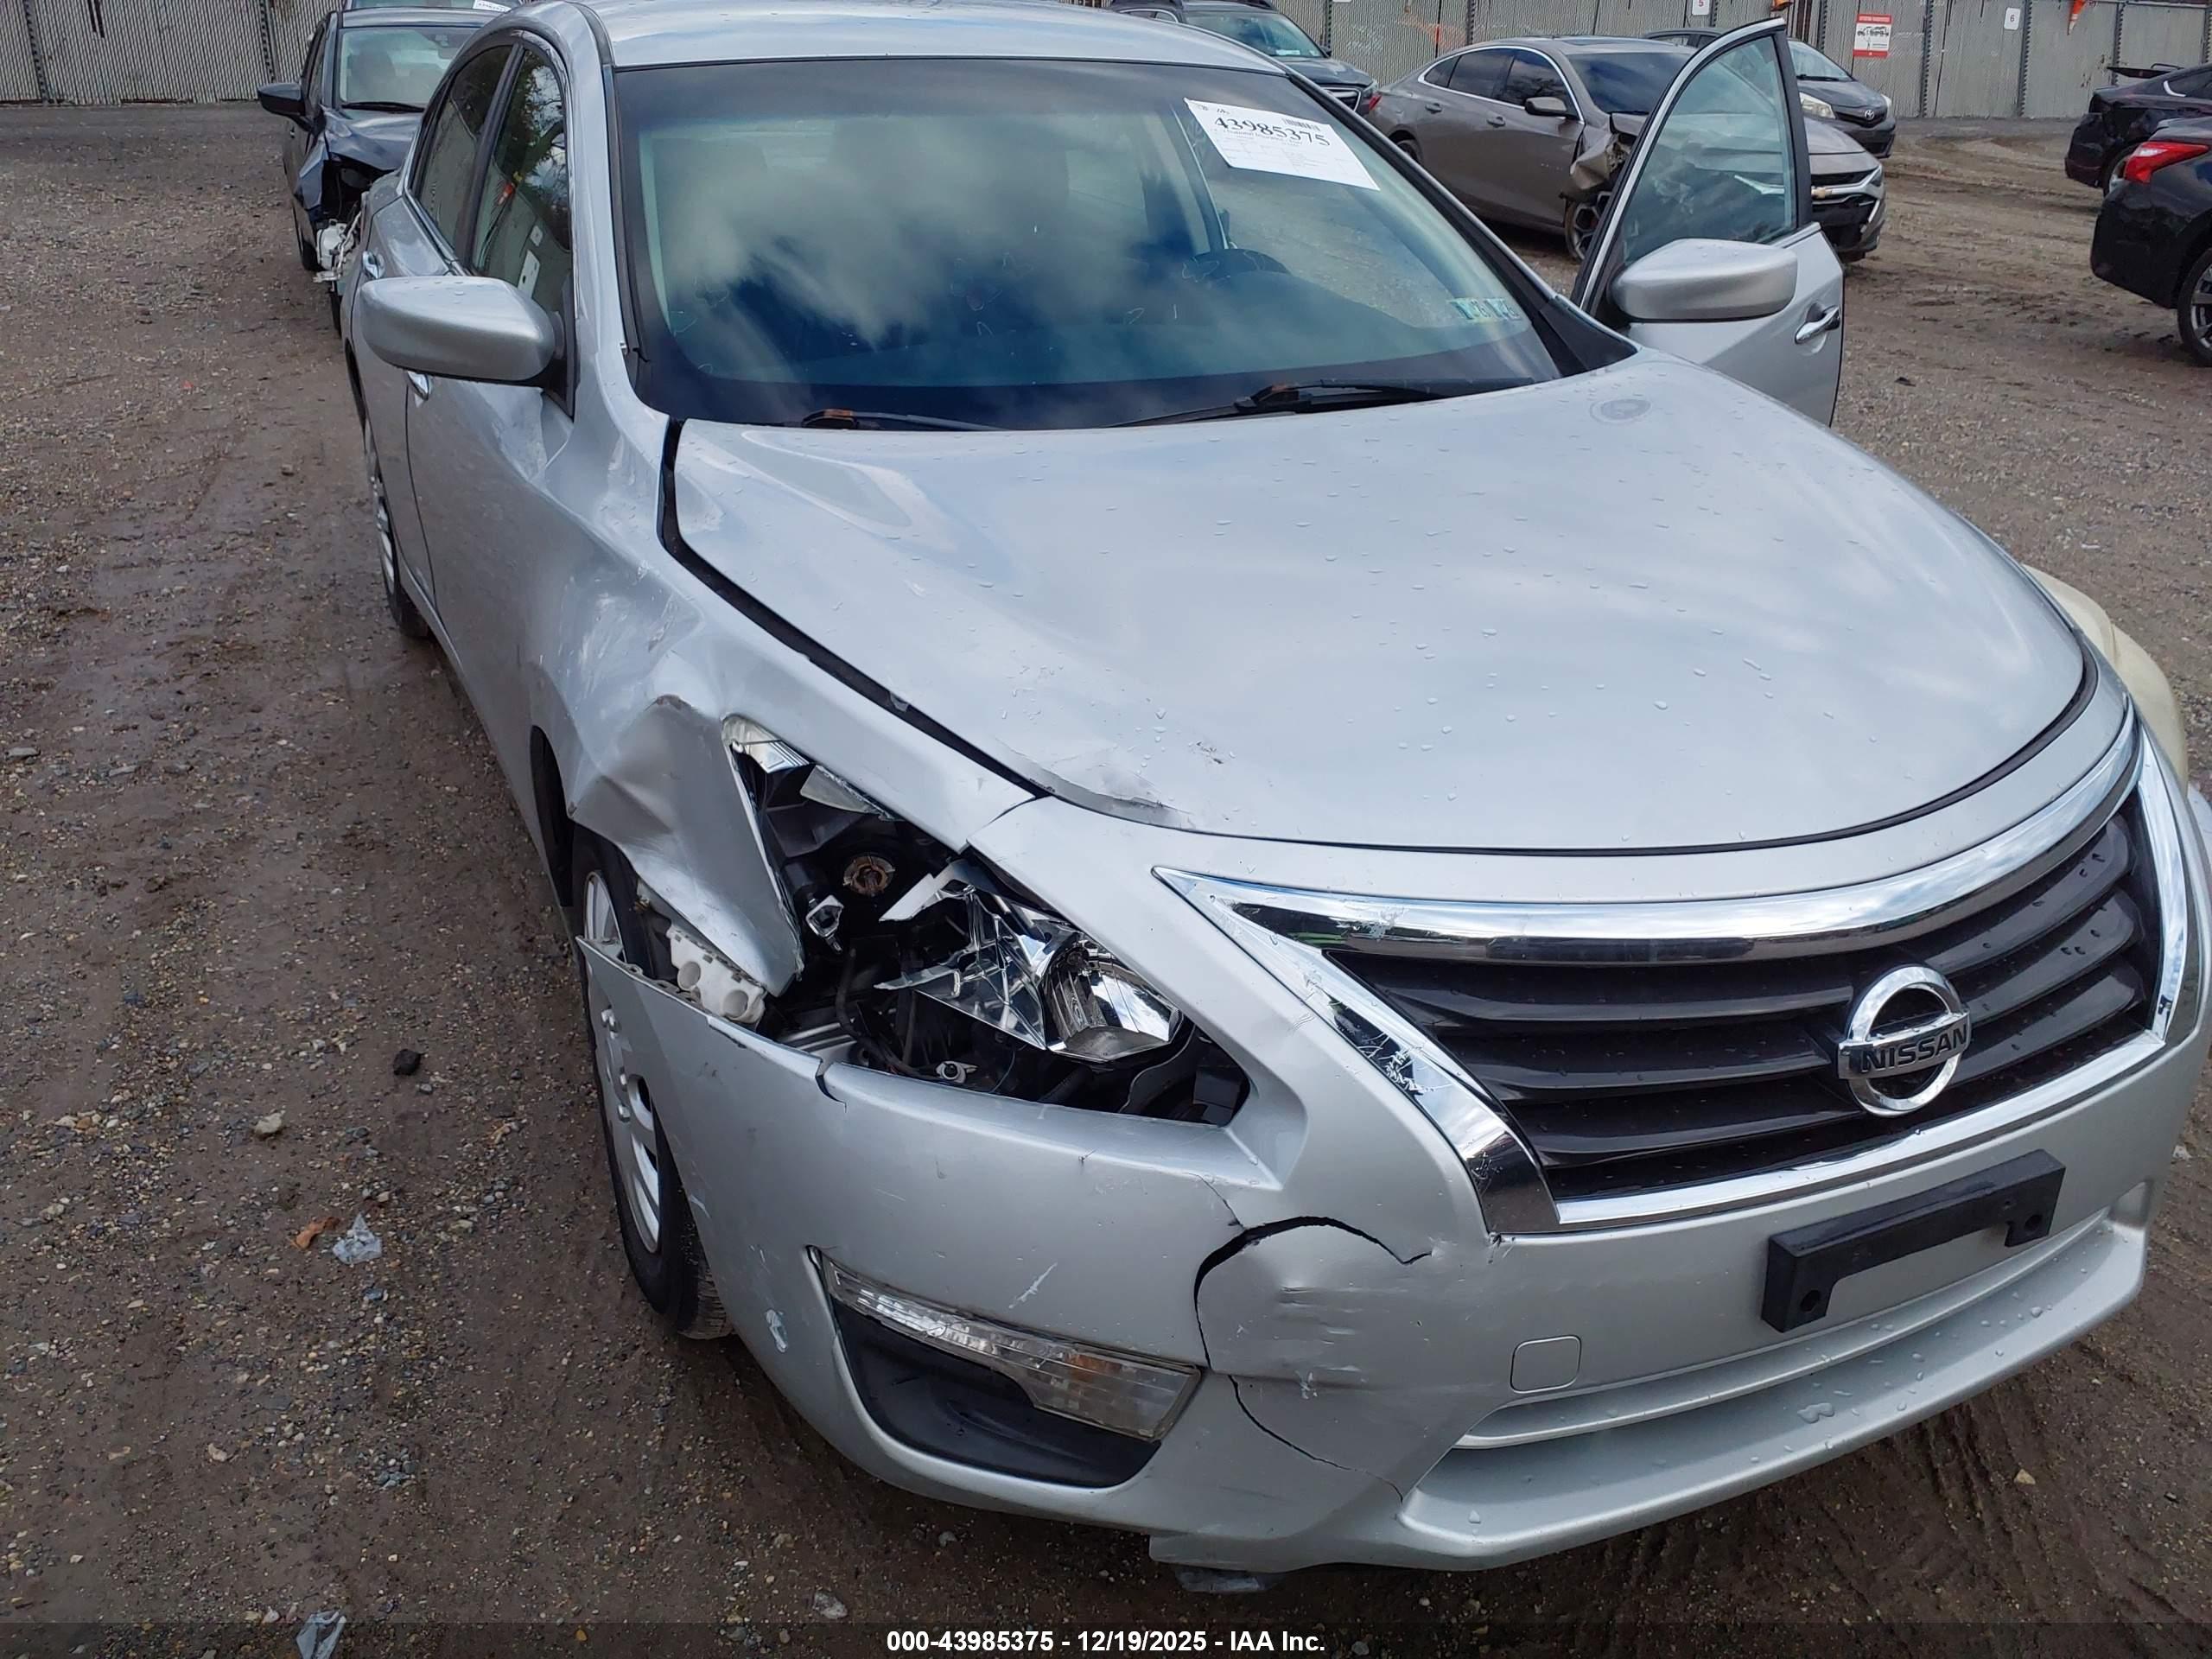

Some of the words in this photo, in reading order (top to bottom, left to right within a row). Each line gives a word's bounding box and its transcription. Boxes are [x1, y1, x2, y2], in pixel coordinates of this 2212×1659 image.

[2010, 14, 2015, 22] 6
[1215, 117, 1331, 146] 43985375
[1859, 1023, 1968, 1073] NISSAN
